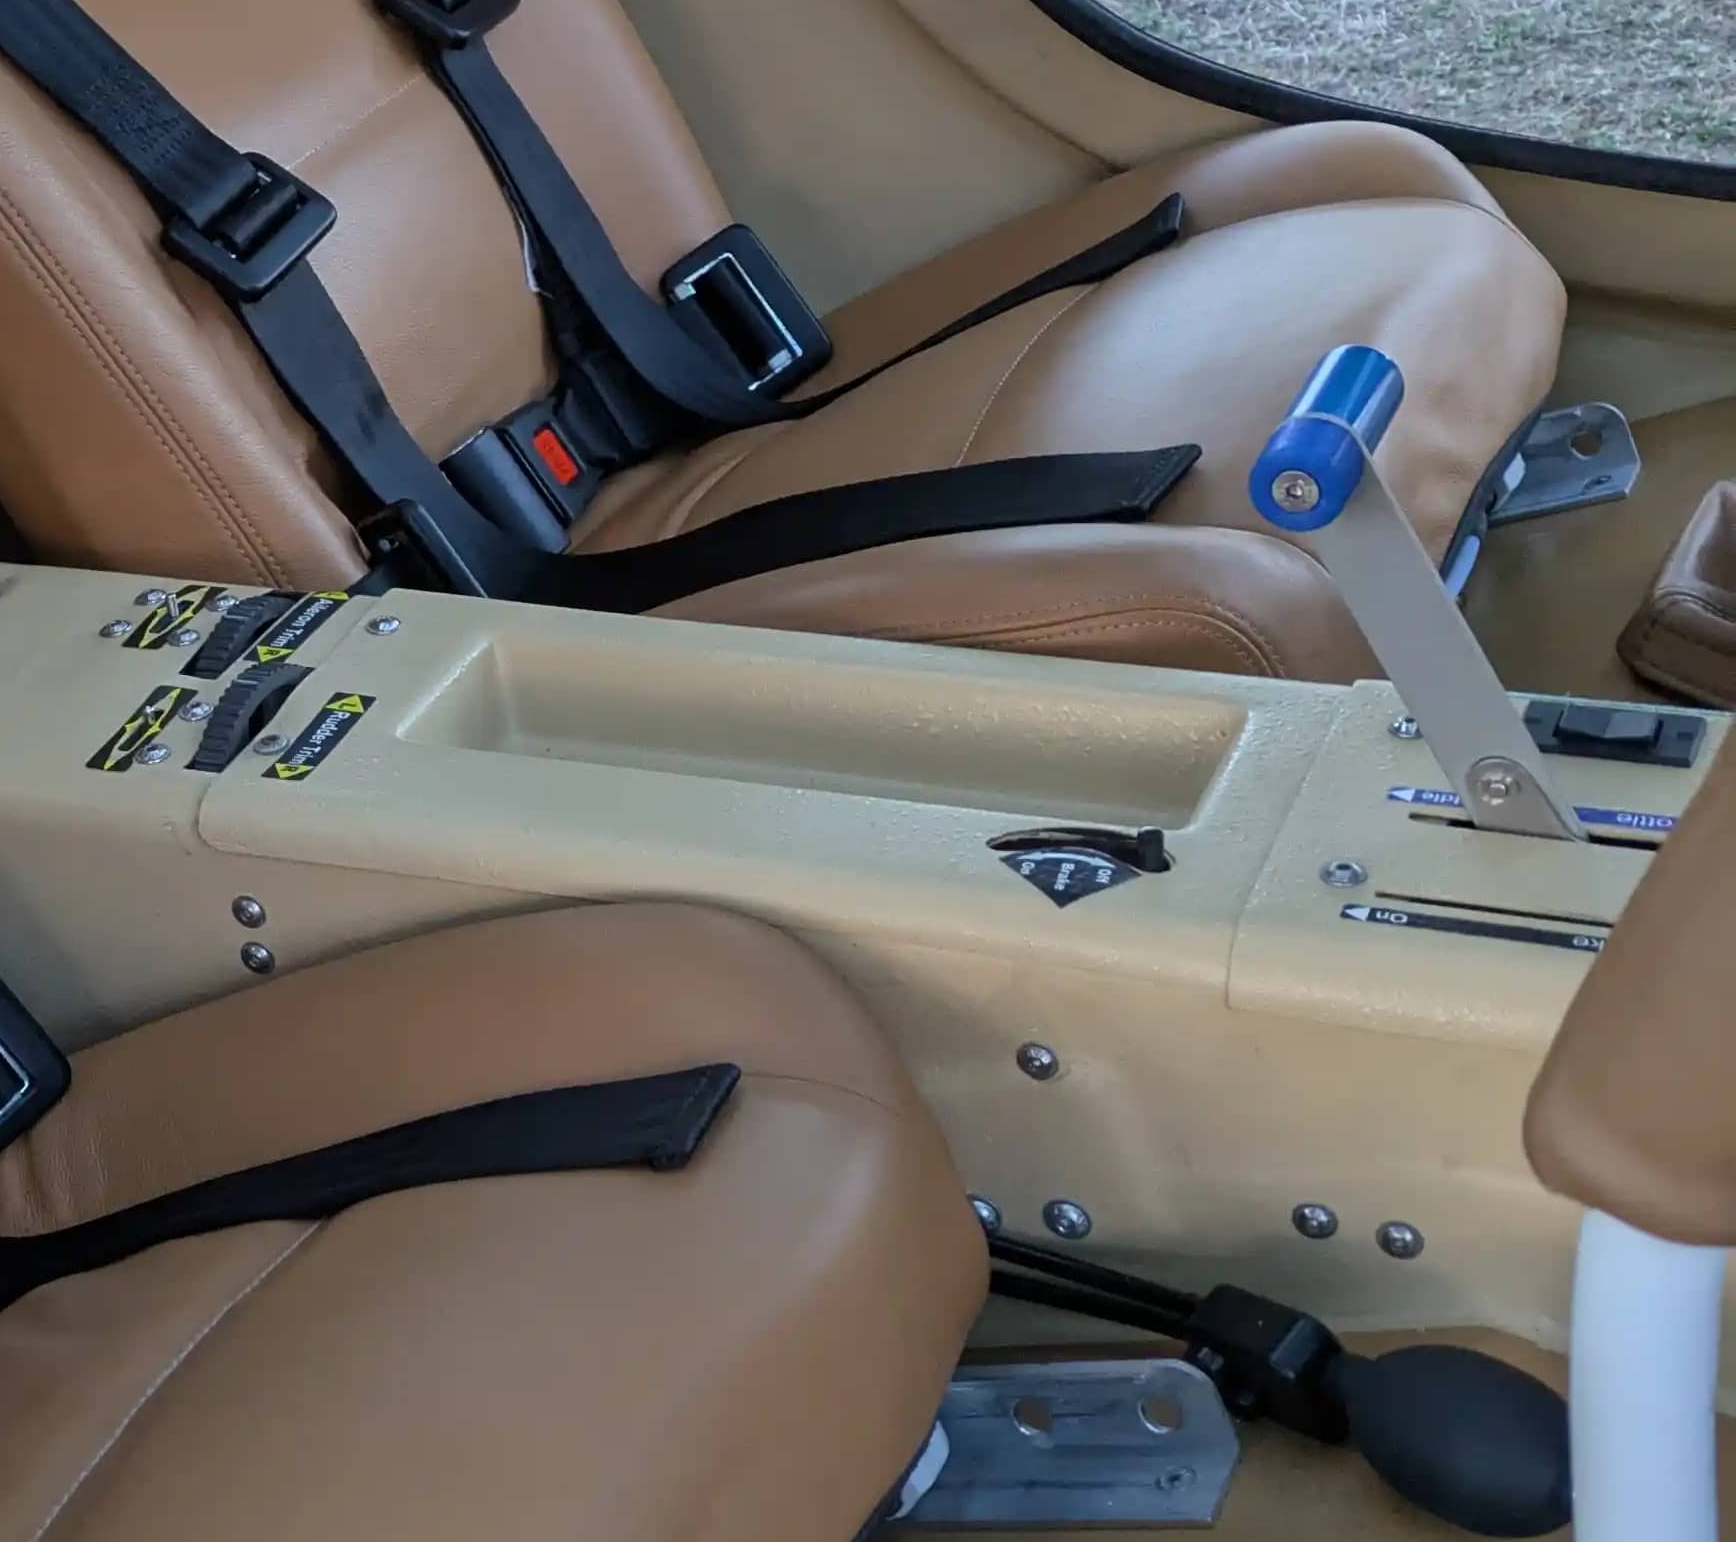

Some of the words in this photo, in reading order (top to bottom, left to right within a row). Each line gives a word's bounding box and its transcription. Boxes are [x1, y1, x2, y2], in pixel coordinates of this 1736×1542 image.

[294, 598, 335, 629] Aileron
[269, 627, 305, 647] Trim
[309, 711, 352, 745] Rudder
[289, 745, 322, 765] Trim
[1421, 792, 1460, 805] Idle
[1615, 812, 1674, 828] ottle
[1053, 862, 1076, 892] Brake
[1095, 867, 1114, 884] Off
[1375, 910, 1409, 924] On
